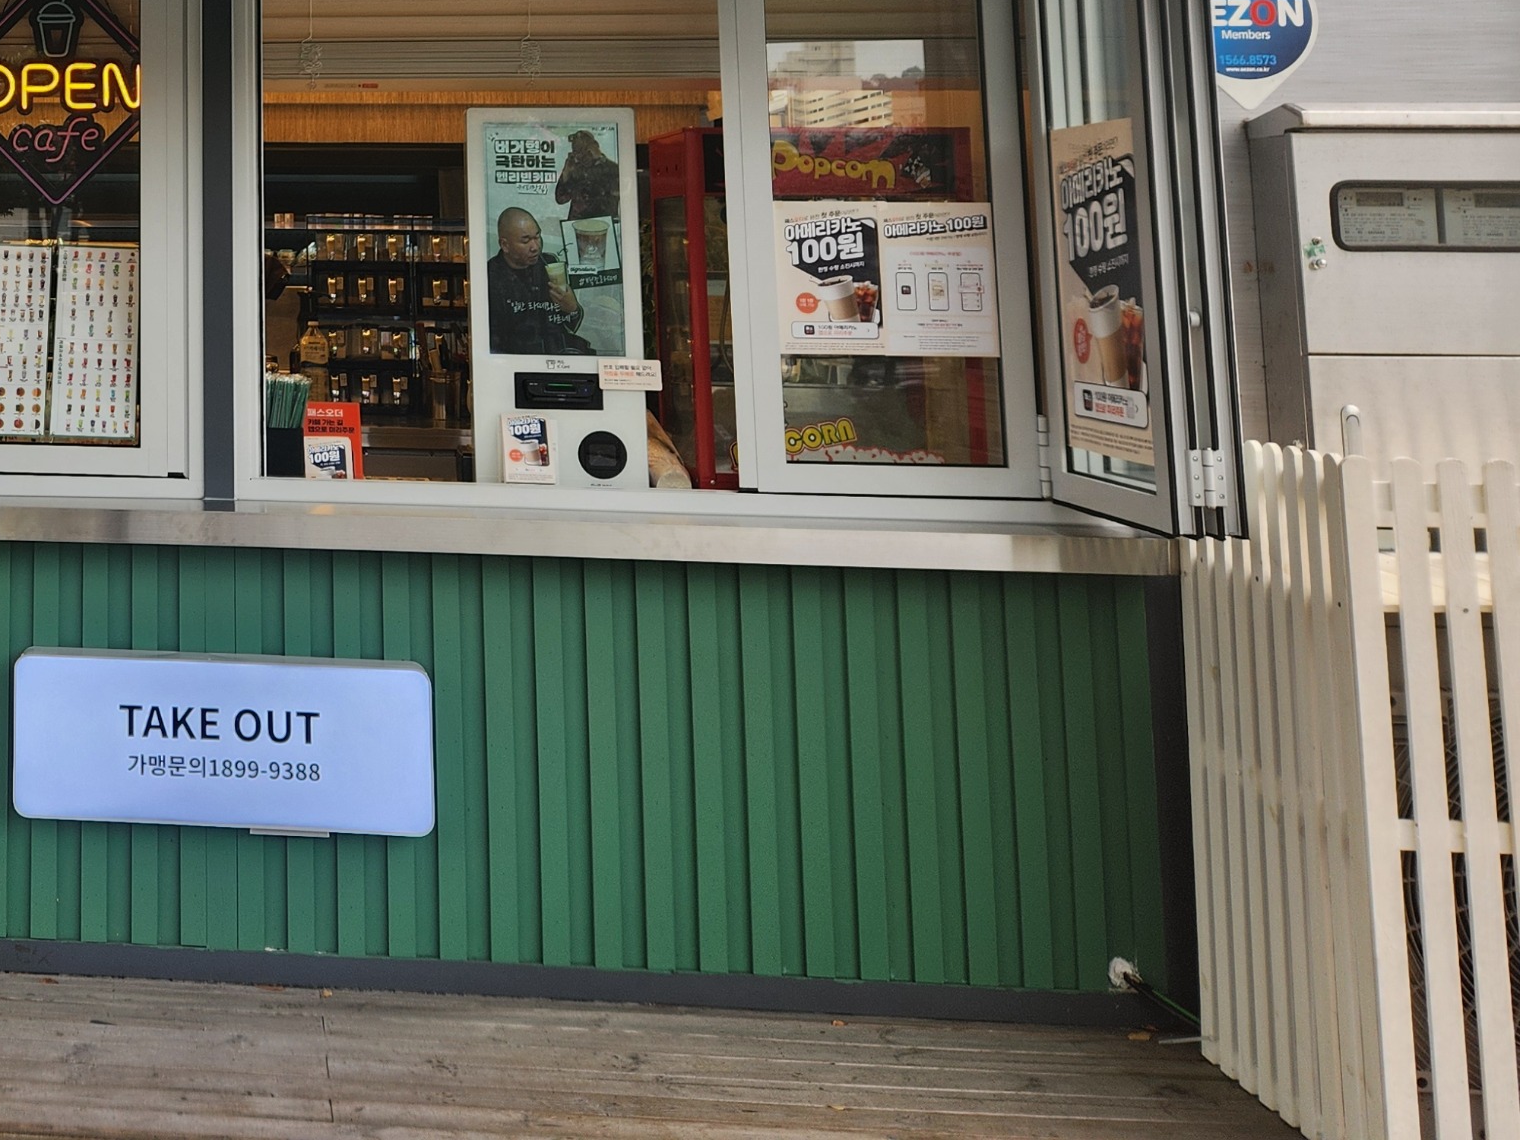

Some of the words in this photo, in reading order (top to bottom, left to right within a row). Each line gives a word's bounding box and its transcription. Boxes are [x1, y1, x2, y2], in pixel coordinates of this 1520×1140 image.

[1221, 30, 1271, 40] Members
[1219, 54, 1277, 65] 1566.8573
[13, 117, 99, 162] cafe
[772, 140, 895, 188] Popcorn
[1061, 156, 1123, 210] 아메리카노
[785, 217, 862, 240] 아메리카노
[884, 219, 945, 238] 아메리카노
[946, 215, 987, 232] 100원
[1063, 188, 1128, 261] 100원
[786, 232, 864, 265] 100원
[307, 408, 344, 417] 패스오더
[509, 424, 541, 435] 100원
[784, 420, 854, 453] CORN
[309, 450, 340, 464] 100원
[119, 703, 220, 740] TAKE
[234, 709, 320, 745] OUT
[127, 753, 320, 782] 가맹문의1899-9388
